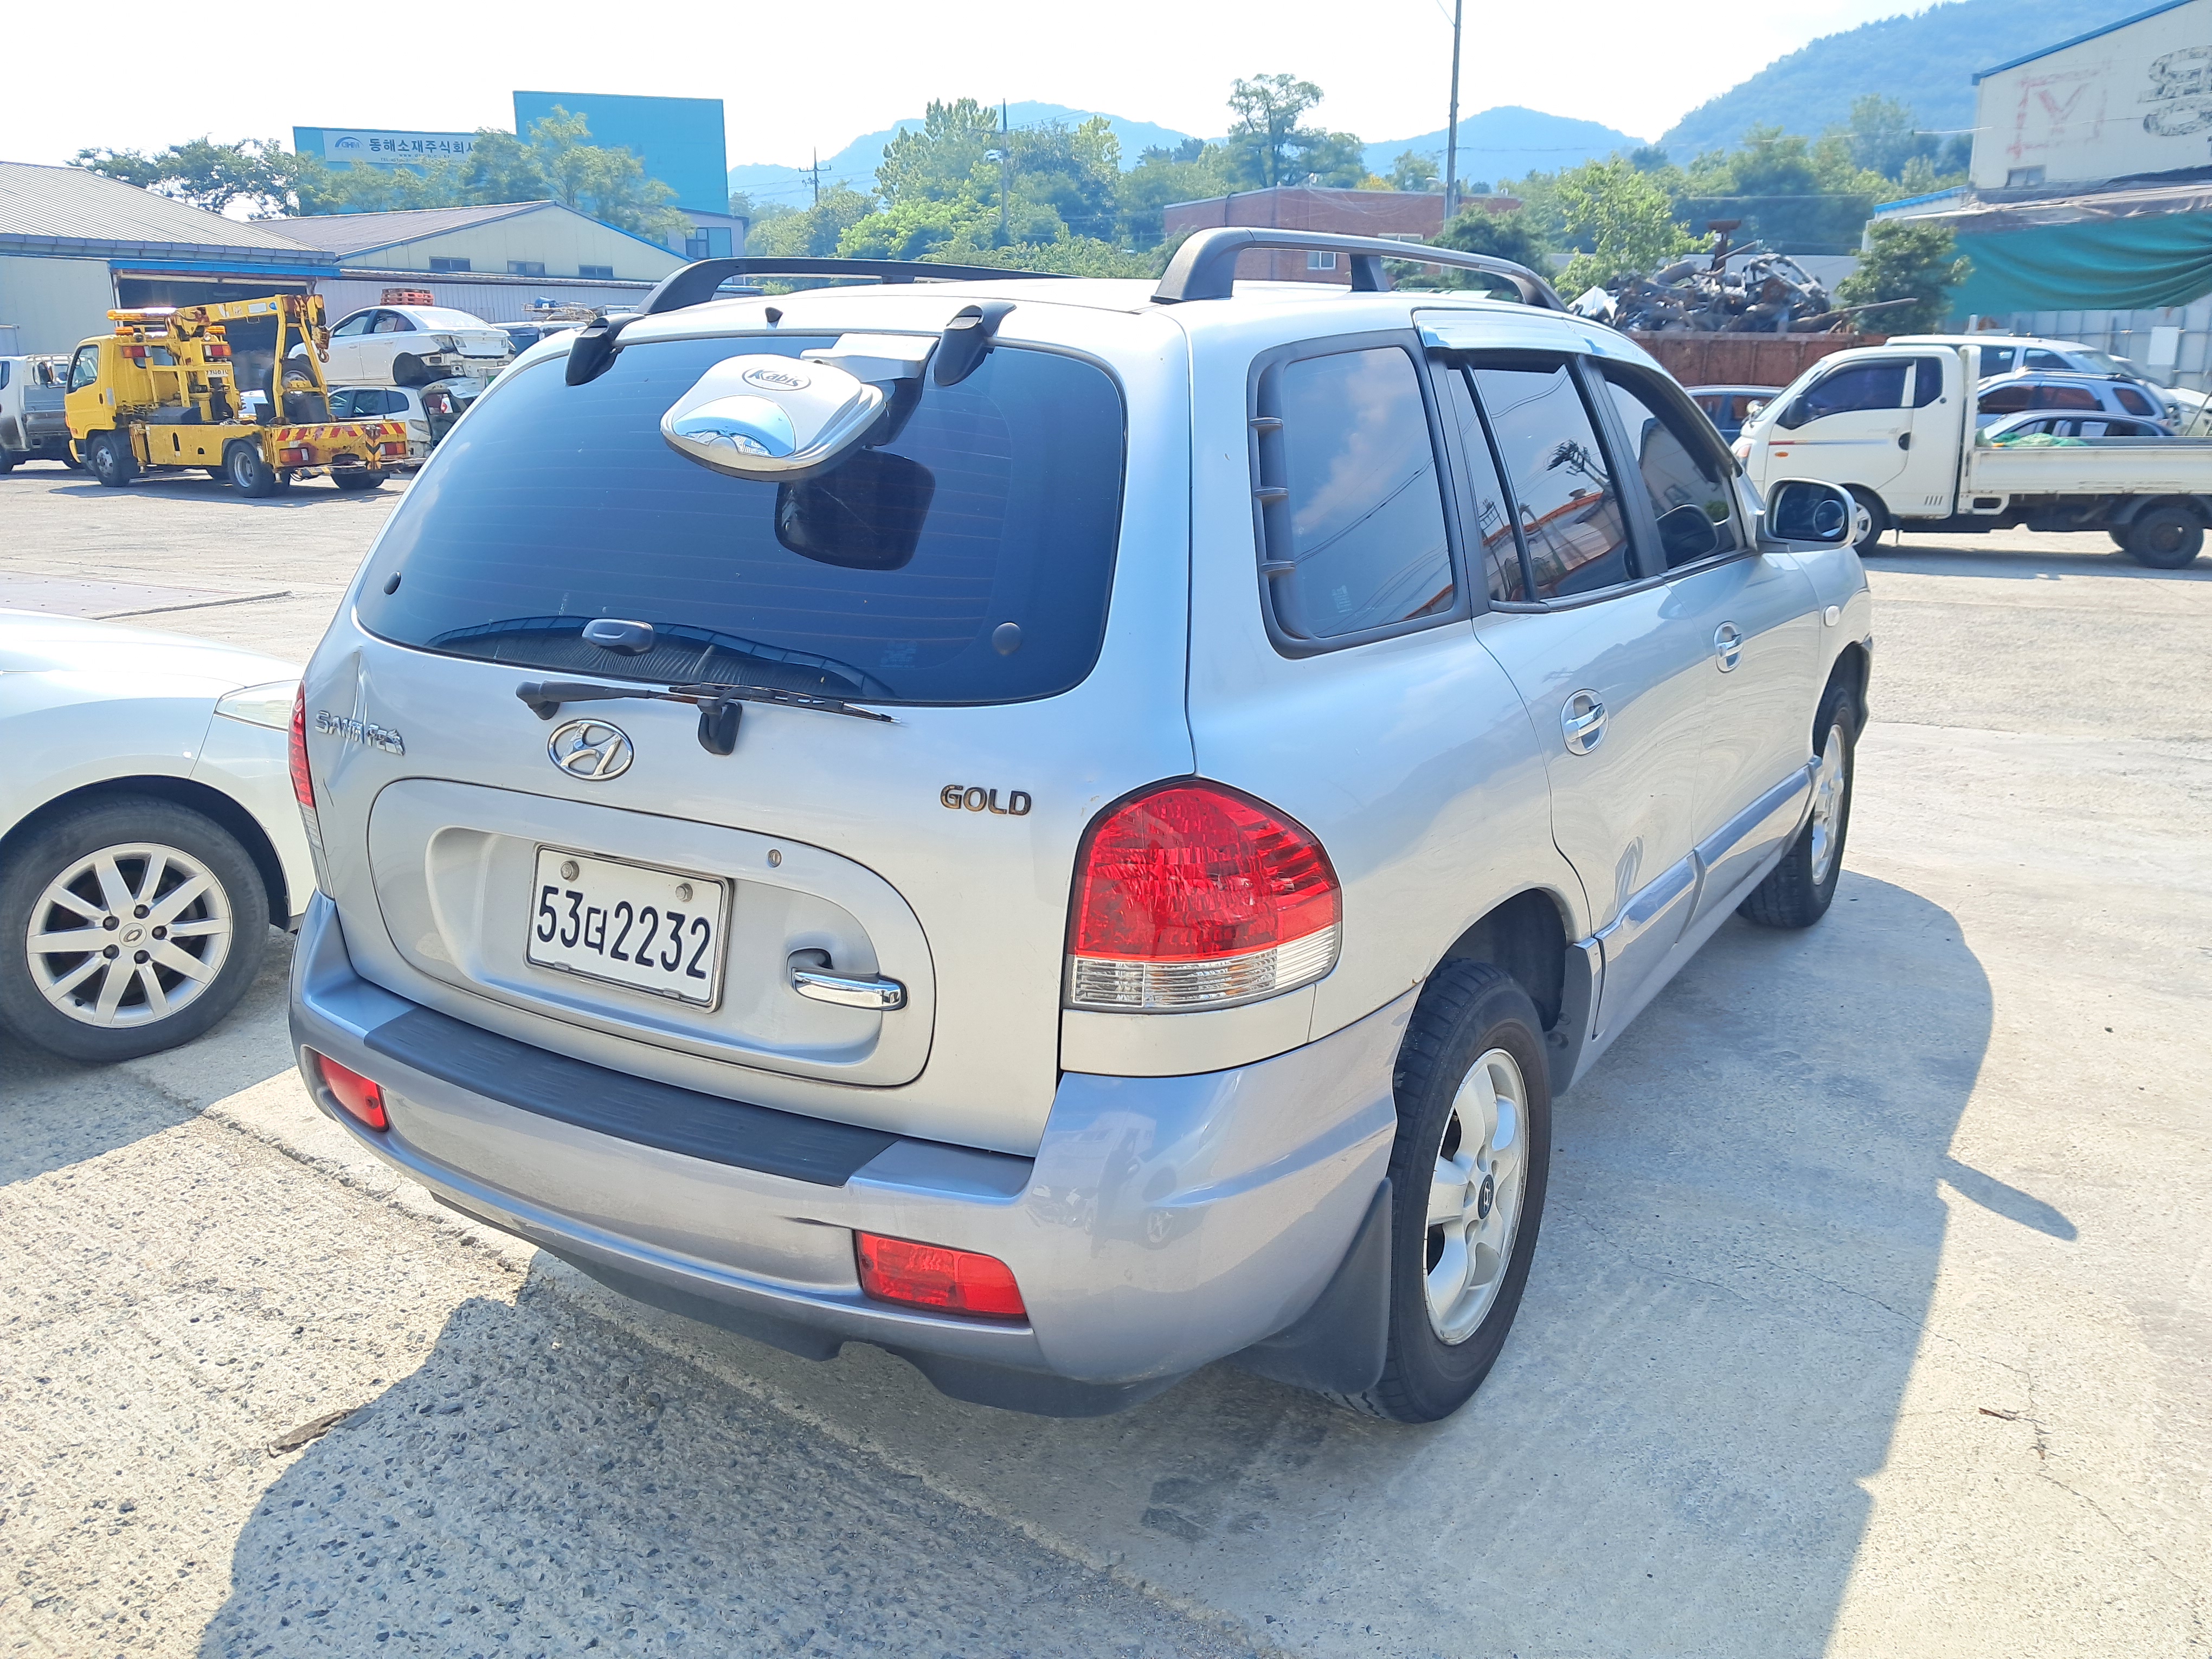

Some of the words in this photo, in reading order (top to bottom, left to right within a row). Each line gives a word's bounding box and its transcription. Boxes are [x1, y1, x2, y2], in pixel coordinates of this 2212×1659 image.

[748, 369, 803, 387] Kabis
[940, 784, 1032, 815] GOLD
[537, 885, 711, 980] 53더2232
